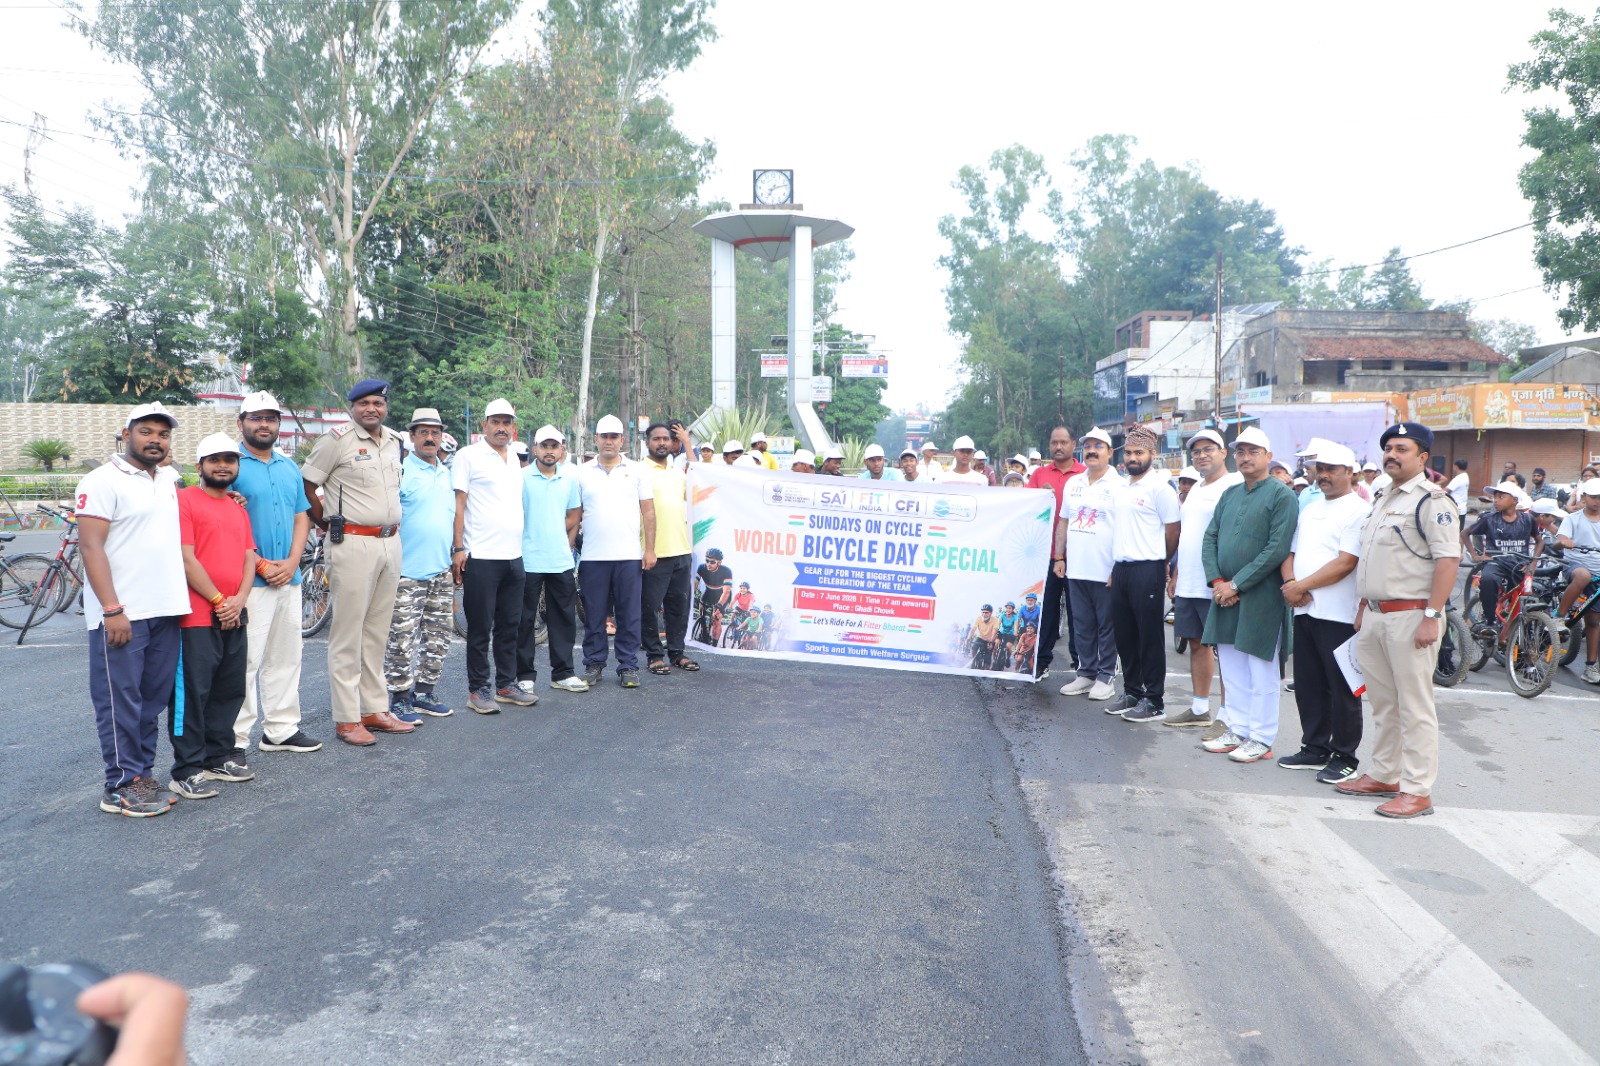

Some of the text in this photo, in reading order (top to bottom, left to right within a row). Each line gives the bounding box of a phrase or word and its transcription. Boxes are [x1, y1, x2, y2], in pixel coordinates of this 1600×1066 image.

[1511, 390, 1533, 403] पूजा
[1535, 387, 1556, 403] मूर्ति
[77, 494, 88, 509] 3
[895, 500, 920, 512] CFI
[809, 515, 922, 537] SUNDAYS ON CYCLE
[734, 529, 998, 573] WORLD BICYCLE DAY SPECIAL
[804, 566, 927, 584] GEAR UP FOR THE BIGGEST CYCLING
[818, 577, 865, 587] CELEBRATION
[878, 581, 891, 589] THE
[893, 583, 911, 591] YEAR
[813, 616, 828, 625] Let's
[830, 618, 844, 626] Ride
[845, 619, 856, 627] For
[864, 621, 882, 630] Fitter
[883, 622, 906, 632] Bharat
[805, 643, 830, 652] Sports
[848, 647, 868, 656] Youth
[870, 649, 898, 658] Welfare
[900, 652, 930, 662] Surguja
